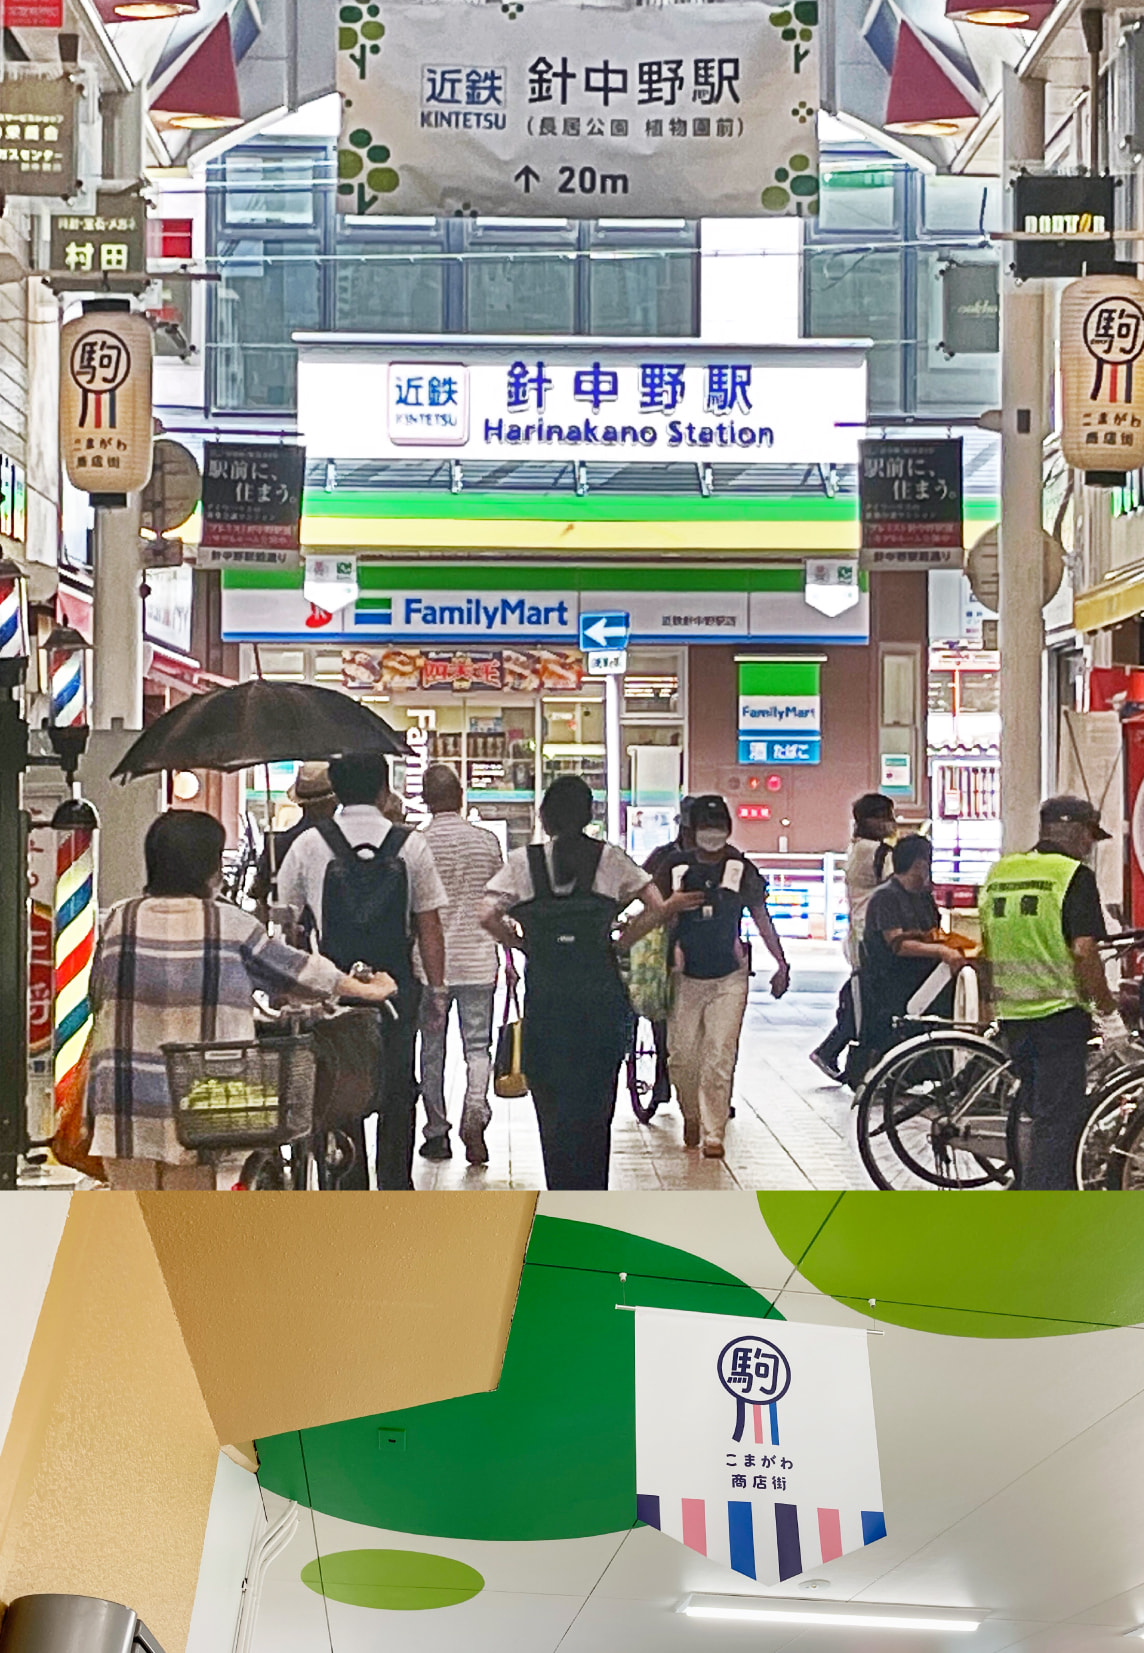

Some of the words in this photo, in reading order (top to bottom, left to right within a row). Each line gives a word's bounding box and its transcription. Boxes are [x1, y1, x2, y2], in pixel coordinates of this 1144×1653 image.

[425, 68, 504, 107] 近鉄
[527, 57, 741, 106] 針中野駅
[420, 110, 507, 131] KINTETSU
[557, 165, 630, 194] 20m
[64, 241, 129, 271] 村田
[1089, 307, 1141, 355] 駒
[75, 340, 122, 385] 駒
[395, 375, 459, 407] 近鉄
[506, 361, 755, 416] 針中野駅
[1081, 411, 1143, 428] こまがわ
[483, 417, 659, 448] Harinakano
[667, 420, 775, 448] Station
[1084, 430, 1135, 446] 商店街
[72, 437, 128, 452] こまがわ
[75, 454, 121, 470] 商店街
[208, 459, 279, 481] 駅前に、
[863, 456, 936, 478] 駅前に、
[235, 481, 297, 504] 住まう。
[892, 479, 958, 501] 住まう。
[403, 598, 570, 633] FamilyMart
[741, 705, 816, 721] FamilyMart
[726, 1346, 780, 1396] 駒
[725, 1452, 794, 1470] こまがわ
[731, 1474, 788, 1491] 商店街
